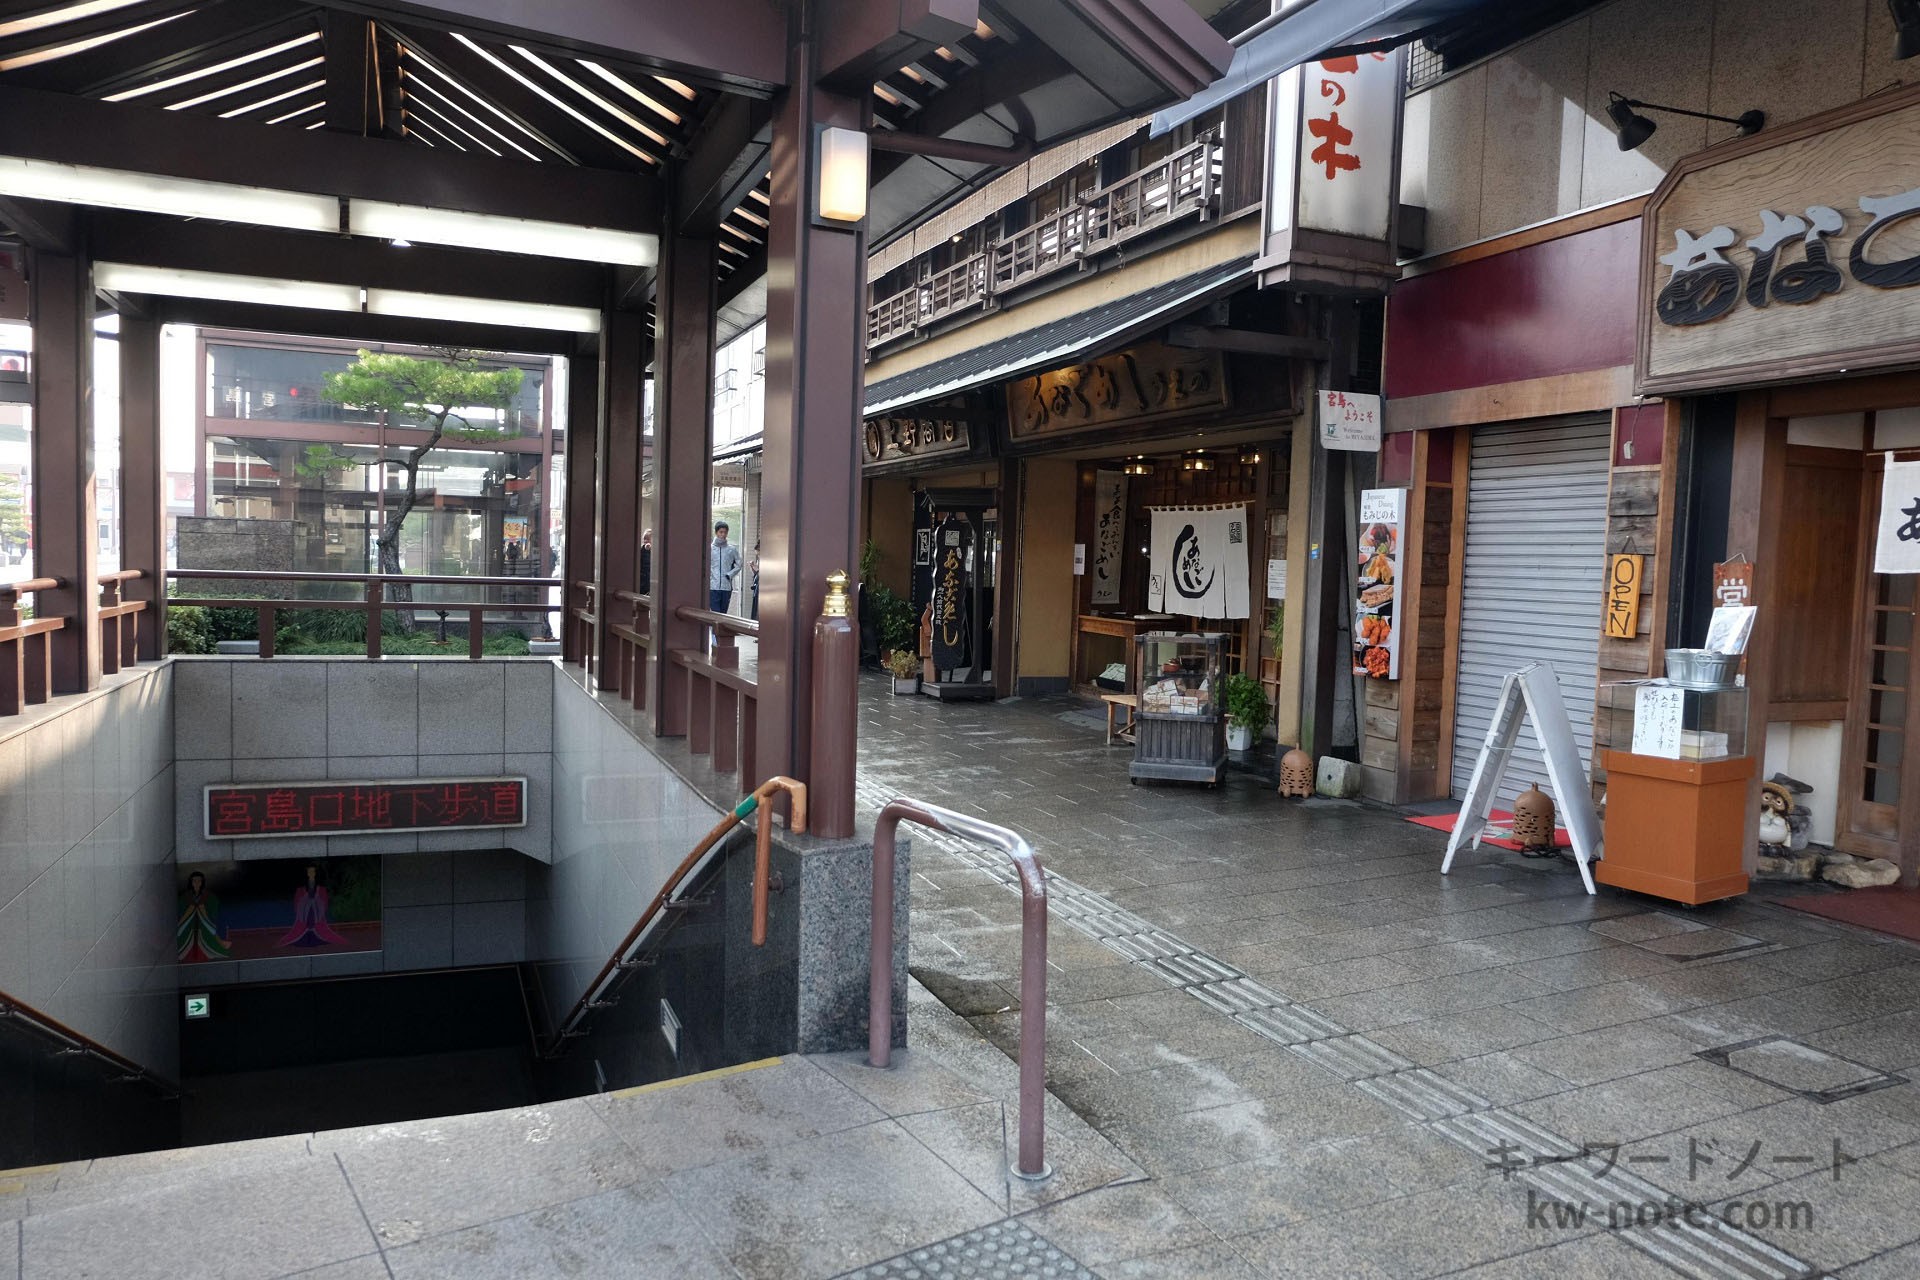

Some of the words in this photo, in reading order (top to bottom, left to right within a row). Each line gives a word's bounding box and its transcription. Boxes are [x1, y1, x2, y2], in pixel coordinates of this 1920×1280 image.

[1328, 391, 1355, 408] 宮島へ
[1345, 409, 1373, 423] ようこそ
[1363, 509, 1397, 521] もみじの木
[1610, 557, 1635, 636] OPEN
[211, 782, 521, 834] 宮島口地下歩道
